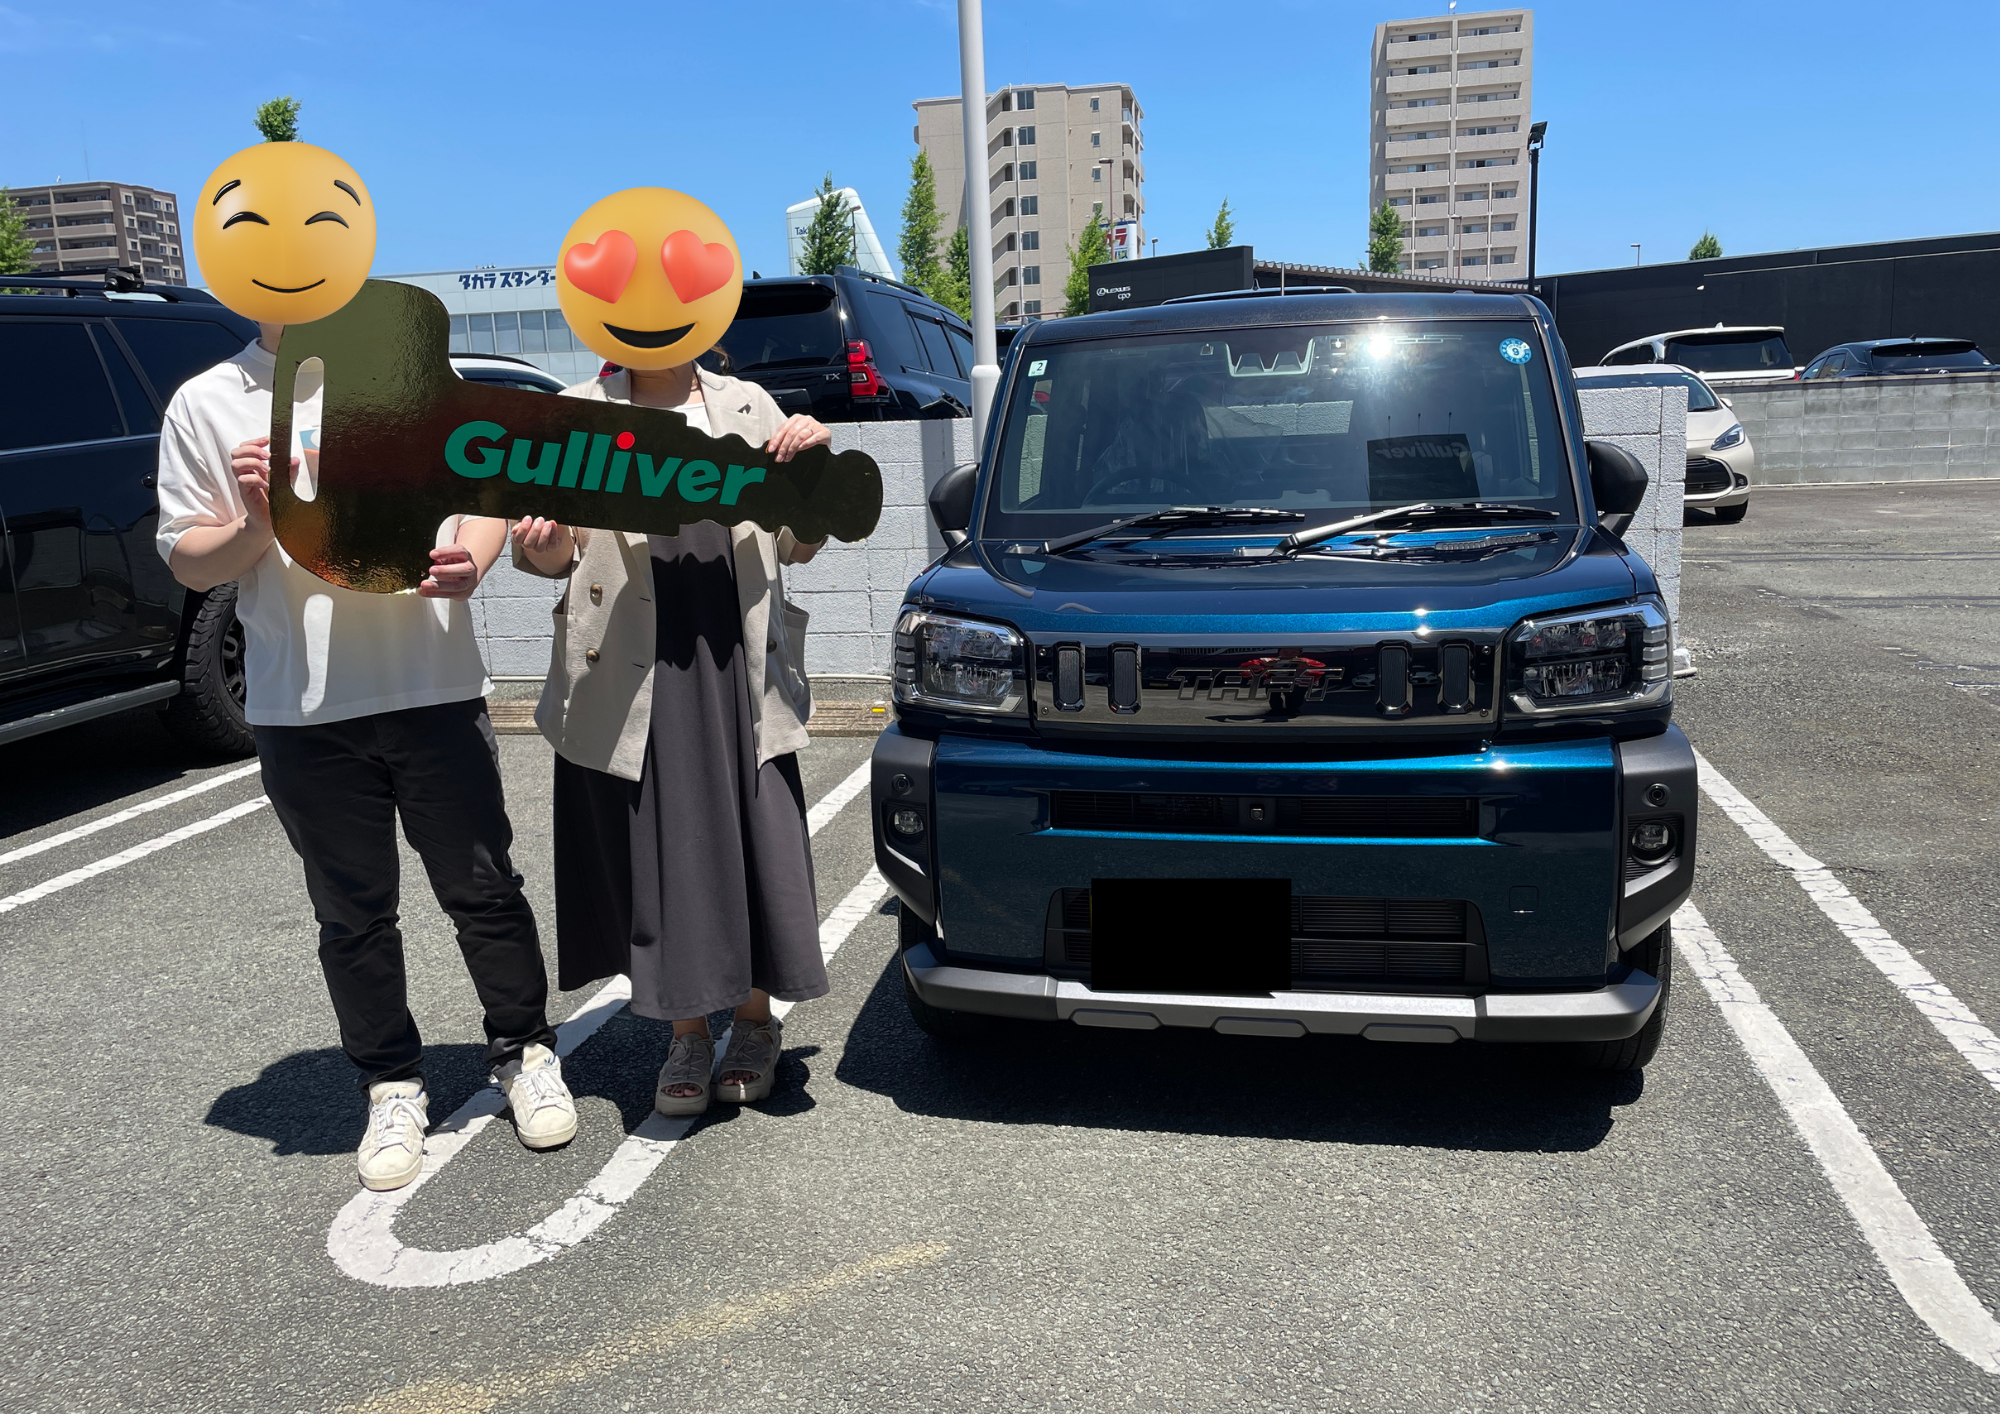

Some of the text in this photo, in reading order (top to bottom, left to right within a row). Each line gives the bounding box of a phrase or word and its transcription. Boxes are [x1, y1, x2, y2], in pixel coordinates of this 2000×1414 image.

[458, 273, 497, 290] タカラ
[1036, 362, 1044, 371] 2
[823, 372, 841, 381] TX
[444, 420, 767, 506] Gulliver
[1166, 667, 1346, 702] TAFT
